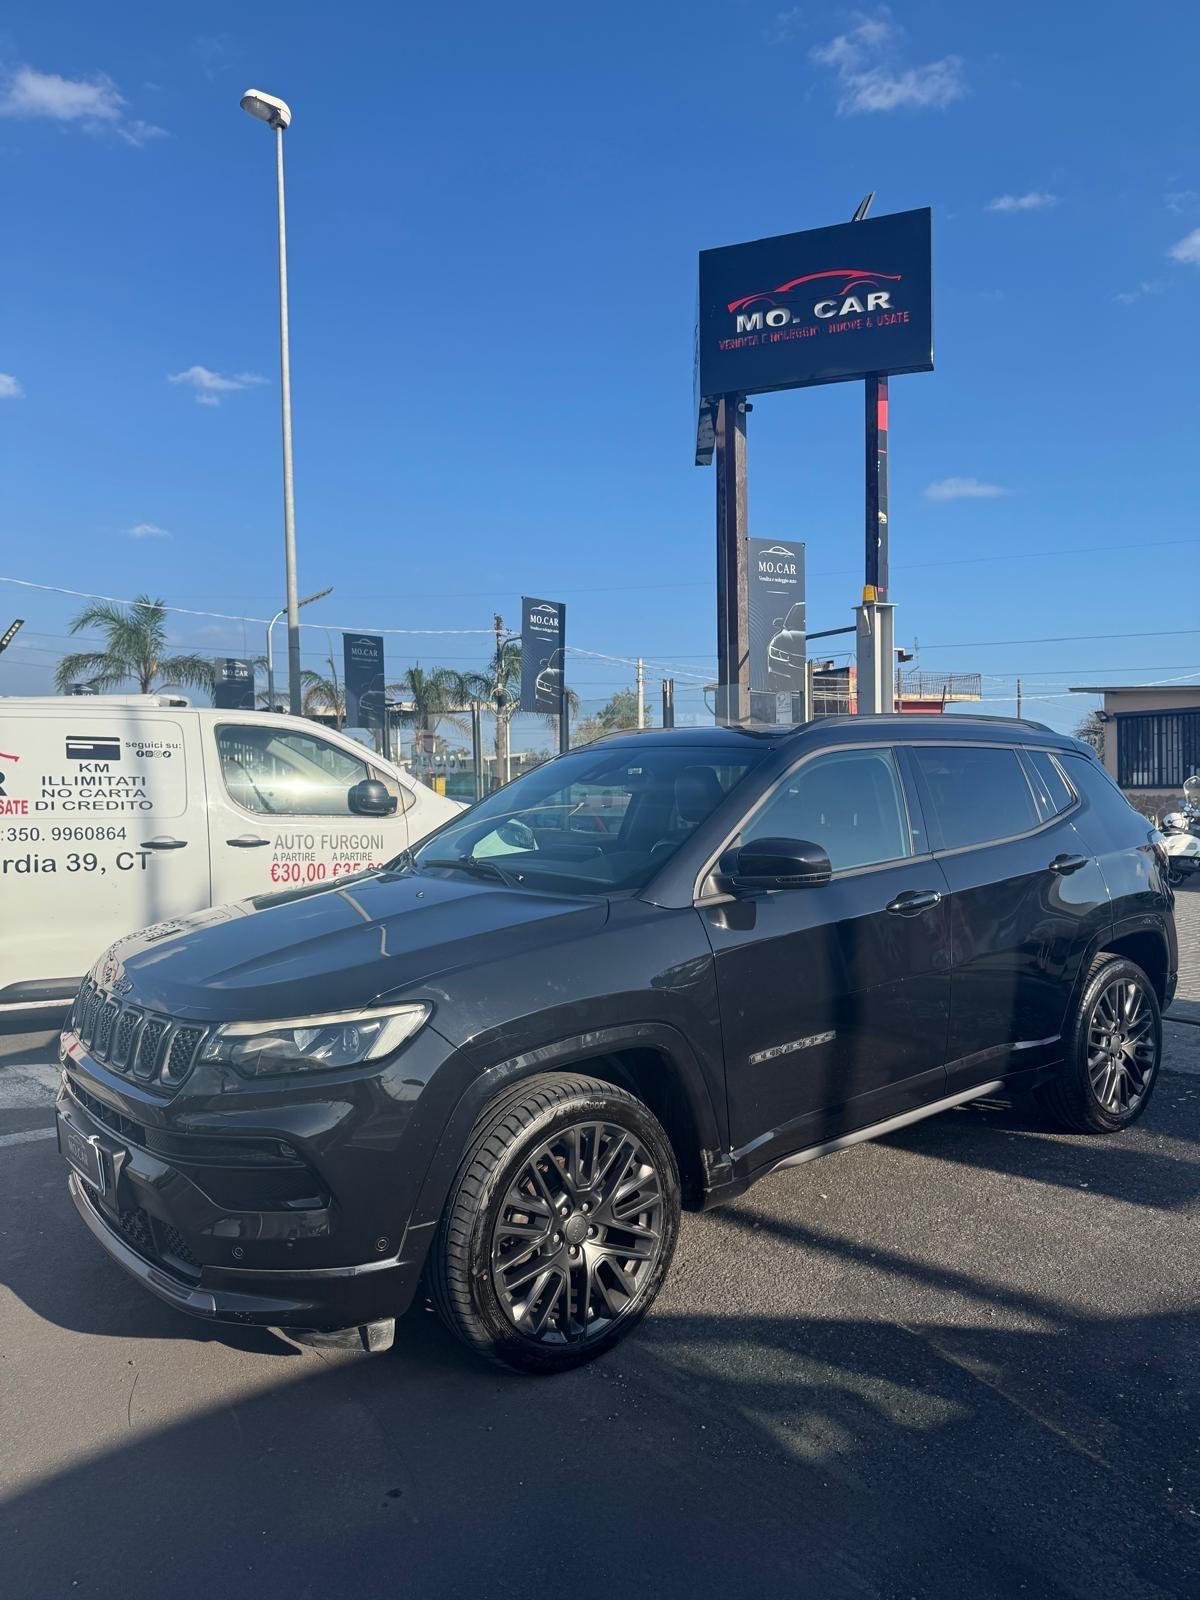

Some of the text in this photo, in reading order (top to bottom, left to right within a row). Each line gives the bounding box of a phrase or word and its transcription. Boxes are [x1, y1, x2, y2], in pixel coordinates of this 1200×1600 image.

[736, 291, 894, 333] MO. CAR
[877, 311, 910, 326] USATE
[758, 561, 796, 574] MO.CAR
[530, 614, 559, 627] MO.CAR
[125, 740, 163, 750] seguici
[79, 763, 110, 773] KM
[41, 775, 146, 786] ILLIMITATI
[42, 788, 147, 798] NO CARTA
[35, 800, 153, 811] DI CREDITO
[51, 827, 128, 841] 9960864
[274, 834, 384, 850] AUTO FURGONI
[66, 852, 106, 875] 39,
[116, 852, 153, 871] CT
[272, 852, 373, 862] A PARTIRE A PARTIRE
[270, 863, 326, 884] €30,00
